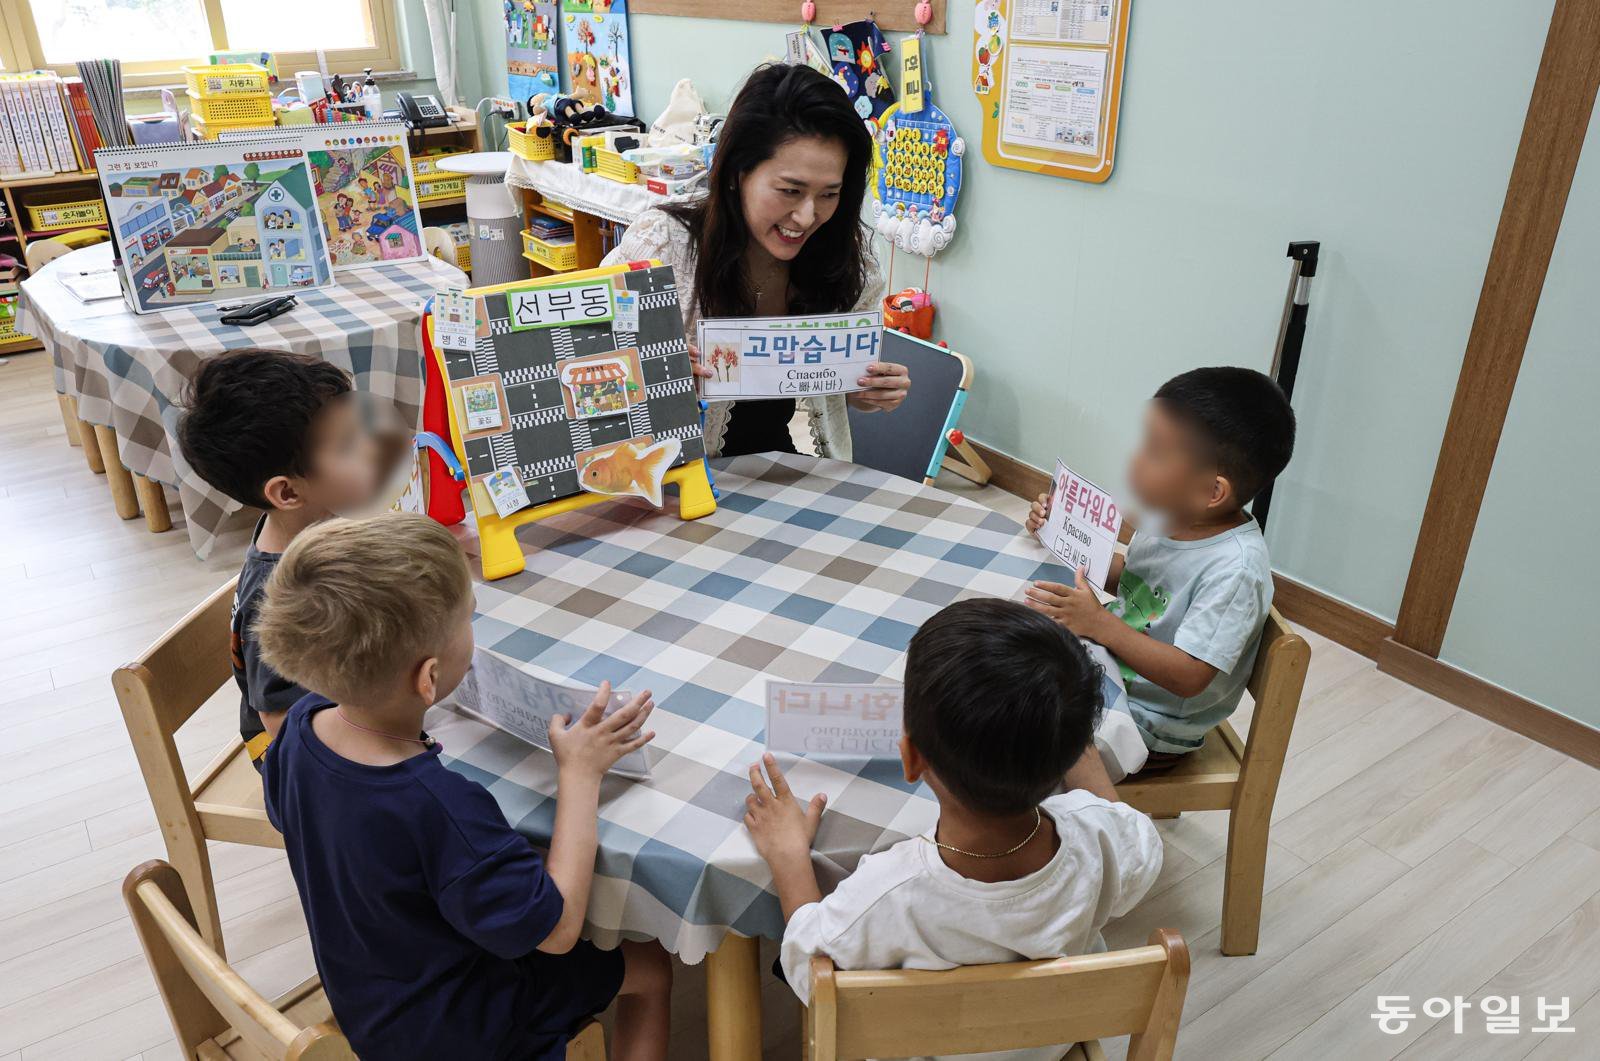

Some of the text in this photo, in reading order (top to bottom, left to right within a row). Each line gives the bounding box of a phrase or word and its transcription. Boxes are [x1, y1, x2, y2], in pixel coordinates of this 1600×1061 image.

[229, 79, 254, 88] 자동차
[107, 161, 158, 171] 그런 집 보았니?
[63, 208, 95, 219] 숫자놀이
[516, 287, 608, 324] 선부동
[442, 334, 467, 347] 병원
[743, 331, 879, 365] 고맙습니다
[787, 368, 837, 380] Спасибо
[1058, 473, 1117, 534] 아름다워요
[1062, 516, 1092, 547] Красиво
